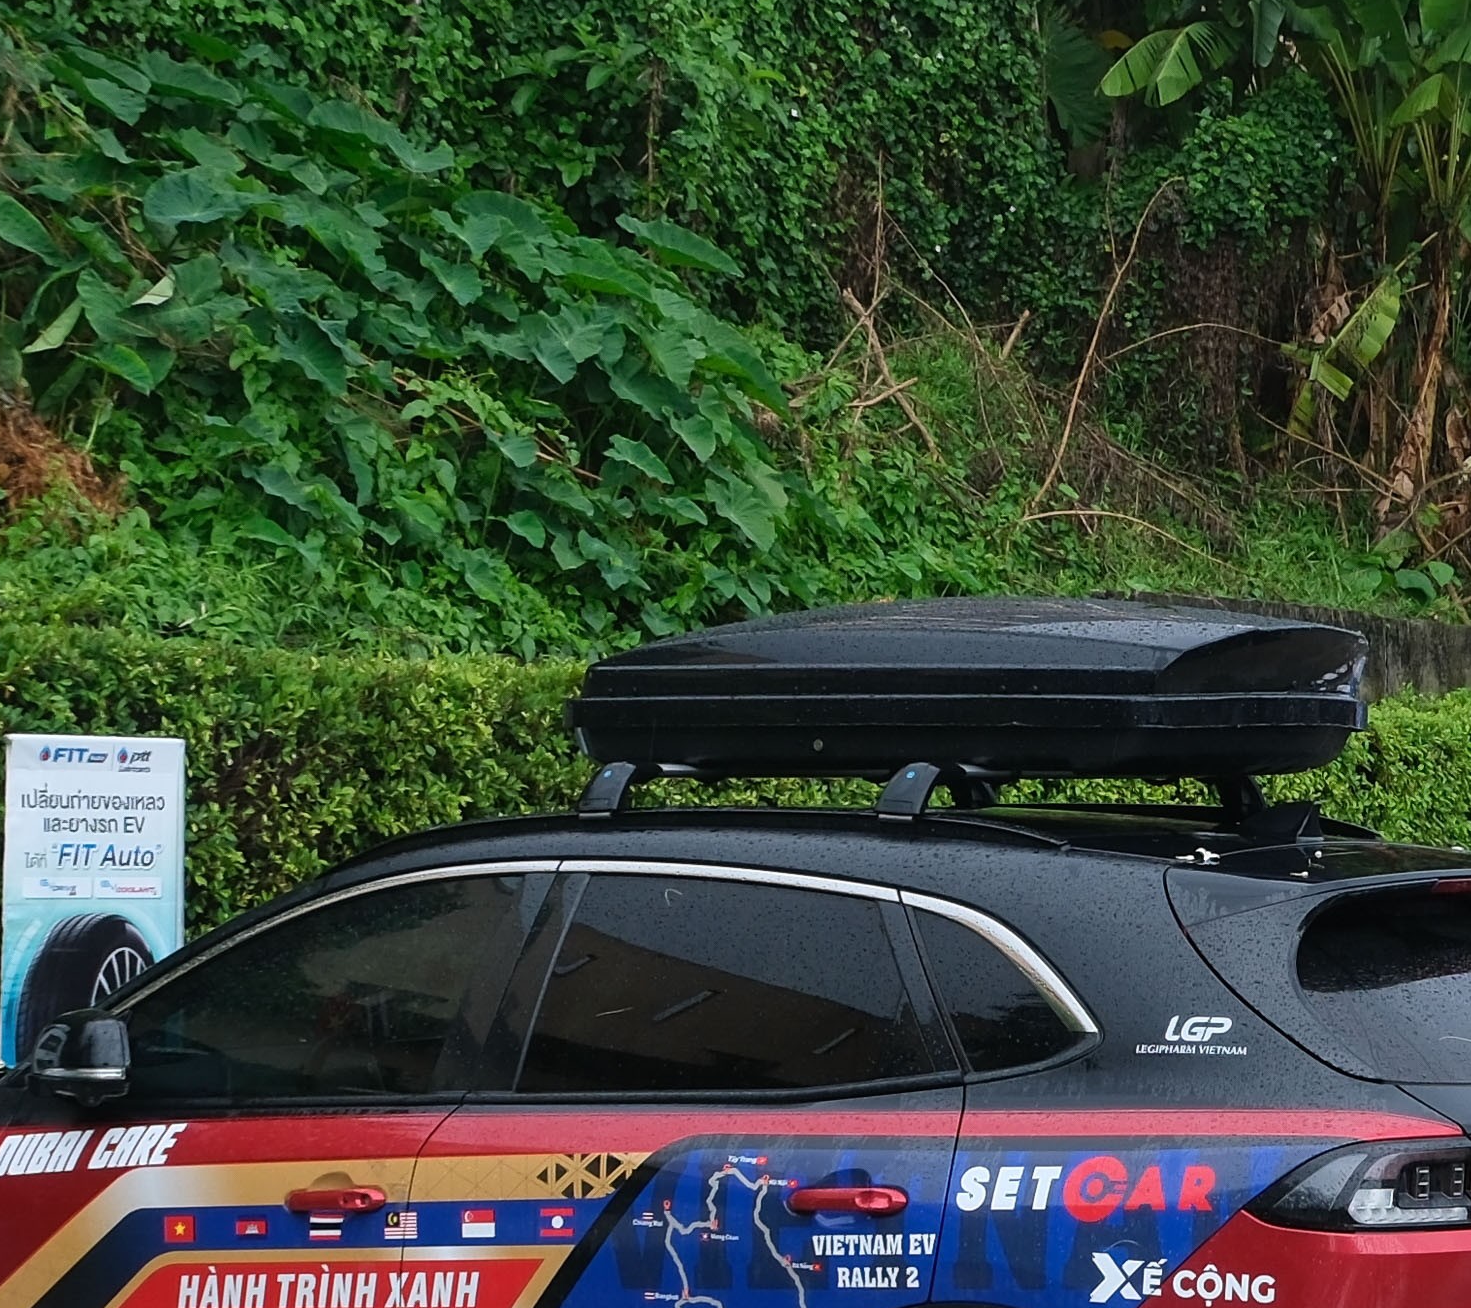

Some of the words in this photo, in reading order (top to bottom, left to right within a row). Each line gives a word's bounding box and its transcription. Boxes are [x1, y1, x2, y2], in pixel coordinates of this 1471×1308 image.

[52, 748, 89, 763] FIT
[129, 750, 152, 764] ptt
[21, 782, 166, 811] เปลี่ยนถ่ายของเหลว
[43, 816, 118, 833] และยางรถ
[123, 817, 146, 833] EV
[1164, 1015, 1232, 1043] LGP
[1135, 1044, 1196, 1055] LEGIPHARM
[1198, 1045, 1248, 1056] VIETNAM
[87, 1123, 188, 1169] CARE
[956, 1155, 1217, 1223] SETCAR
[812, 1233, 903, 1256] VIETNAM
[909, 1233, 936, 1256] EV
[277, 1263, 376, 1308] TRÌNH
[383, 1271, 480, 1308] XANH
[837, 1267, 901, 1288] RALLY
[906, 1267, 920, 1288] 2
[1089, 1251, 1168, 1304] XẾ
[1172, 1263, 1276, 1307] CỘNG
